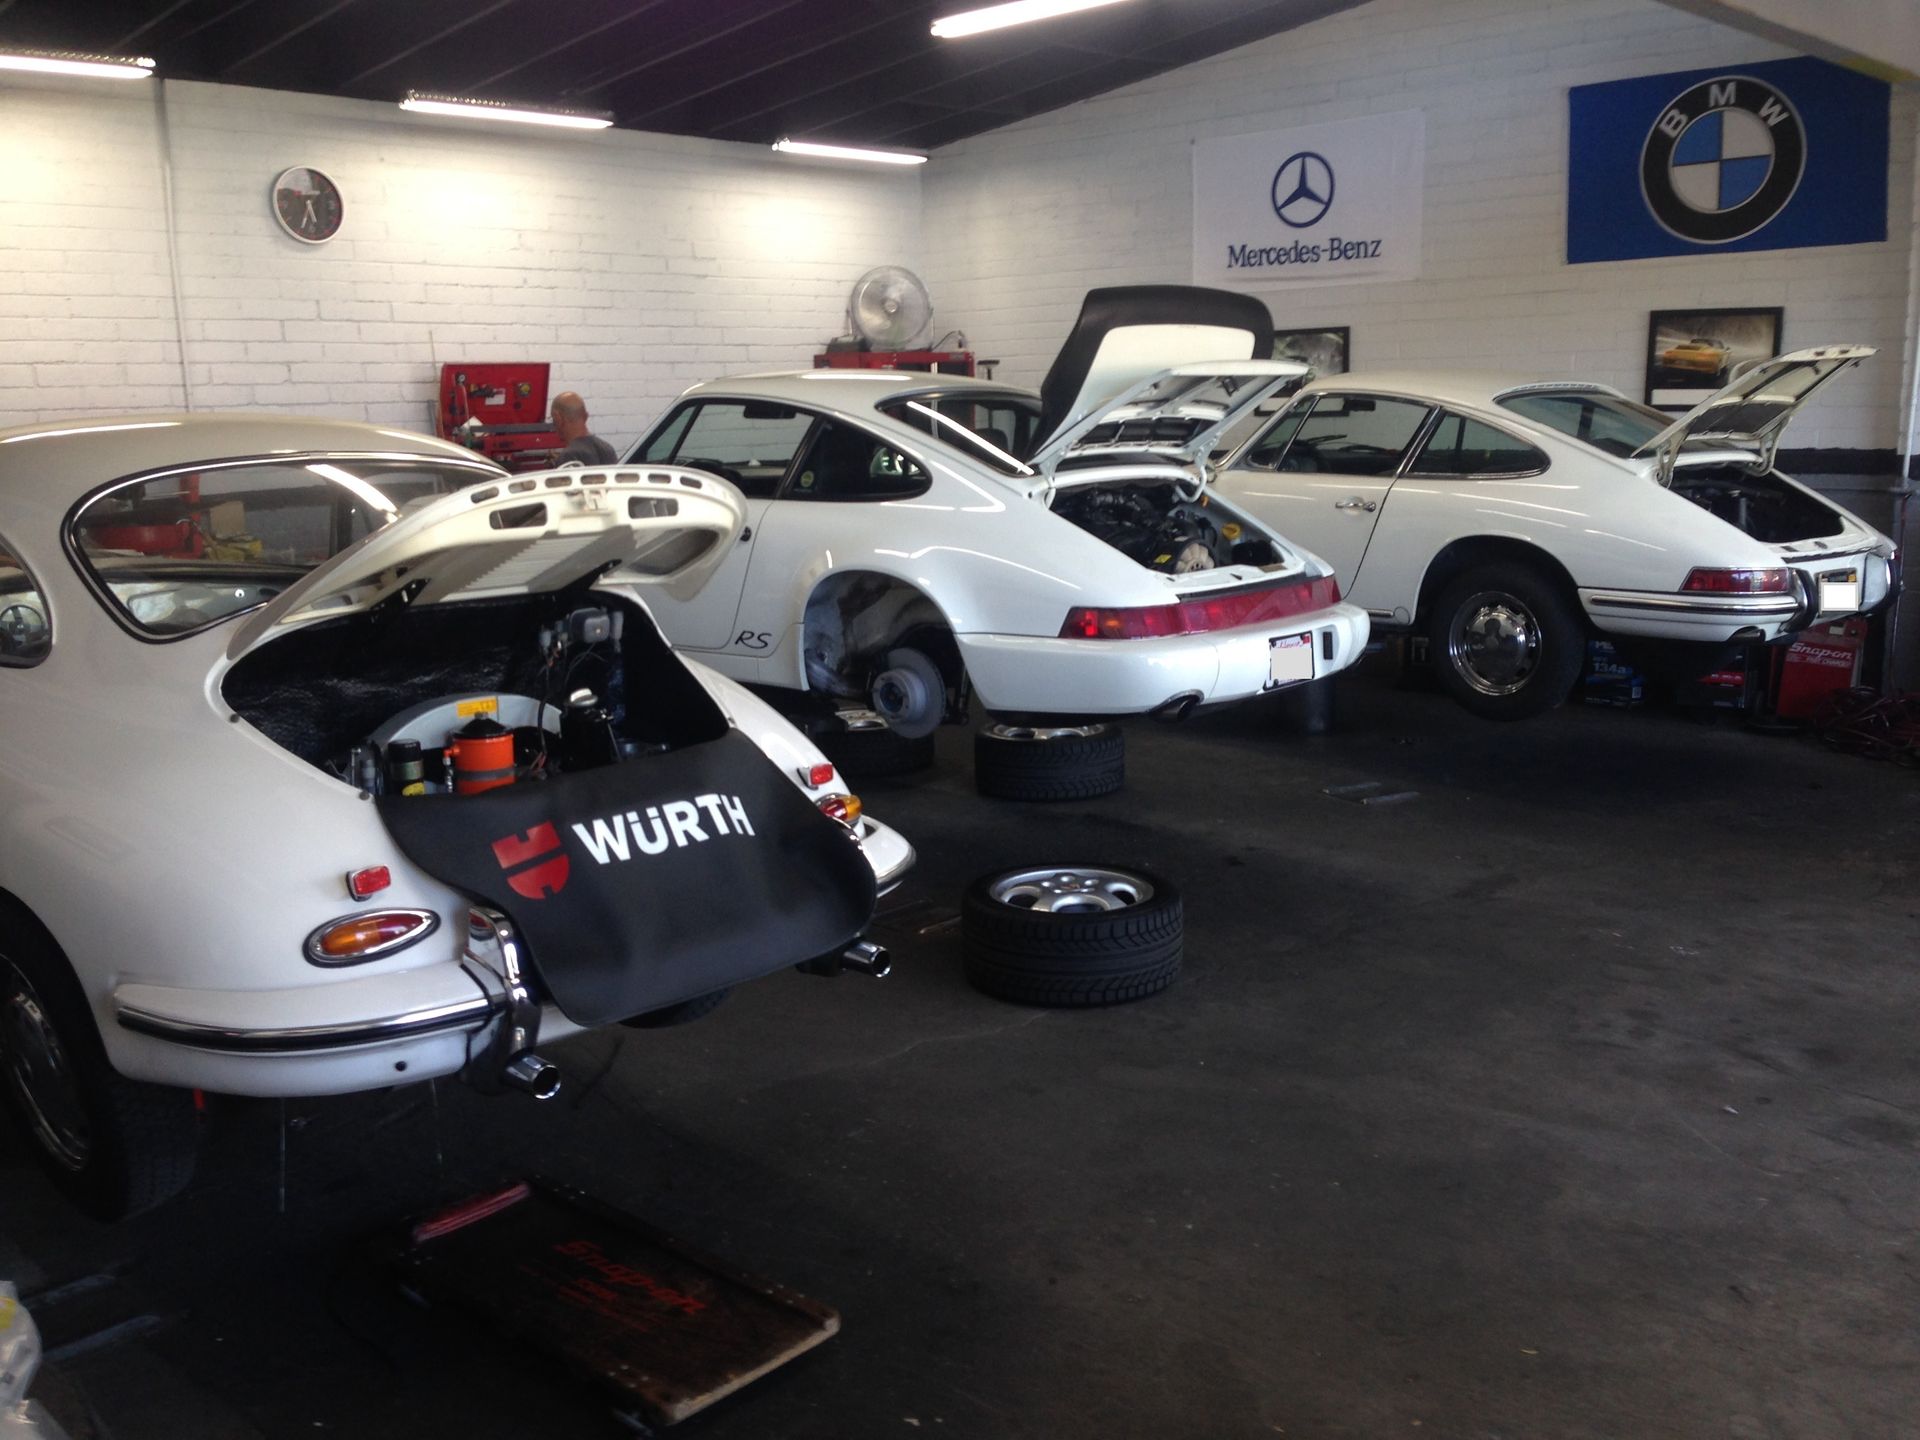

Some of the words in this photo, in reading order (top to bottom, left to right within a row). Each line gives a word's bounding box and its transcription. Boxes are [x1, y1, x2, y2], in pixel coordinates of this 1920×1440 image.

[1659, 80, 1788, 139] BMW
[1227, 237, 1382, 269] Mercedes-Benz
[735, 629, 772, 651] RS
[1788, 642, 1853, 660] Snap-on
[1593, 662, 1626, 674] 134a
[572, 792, 755, 865] WÜRTH
